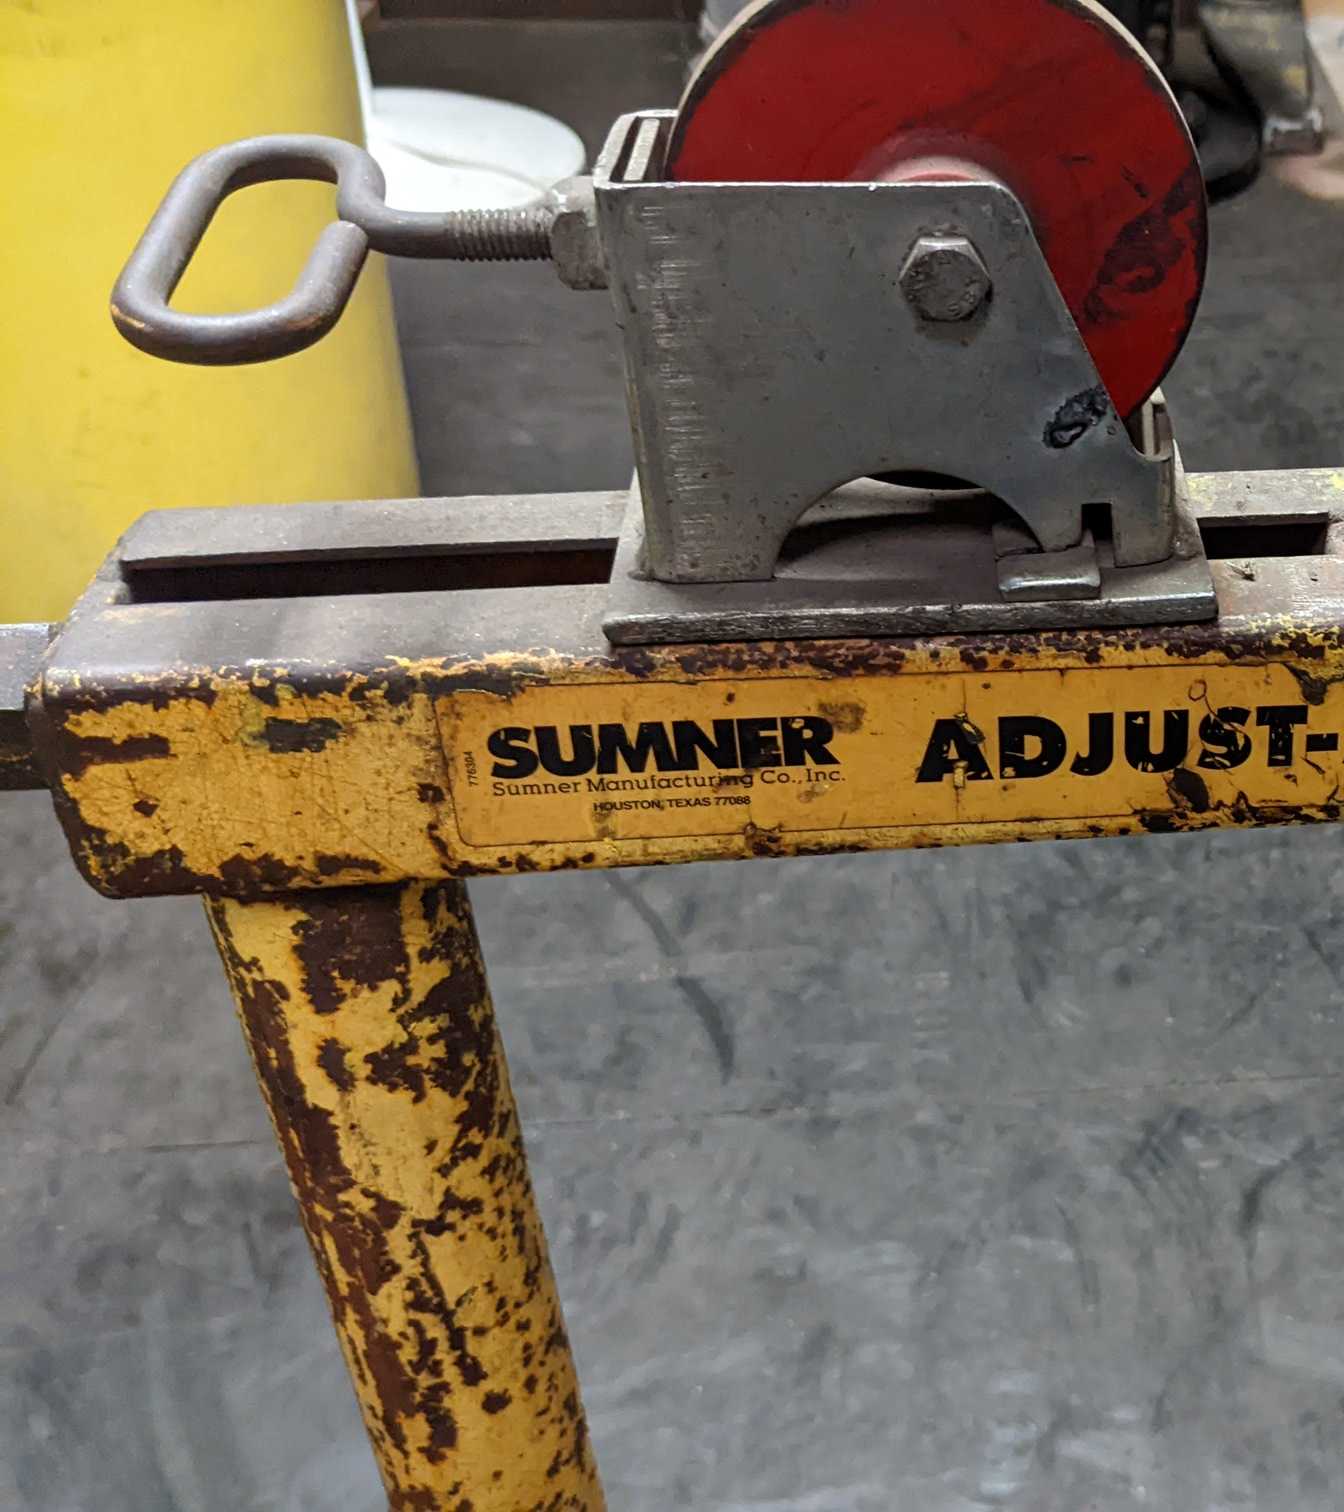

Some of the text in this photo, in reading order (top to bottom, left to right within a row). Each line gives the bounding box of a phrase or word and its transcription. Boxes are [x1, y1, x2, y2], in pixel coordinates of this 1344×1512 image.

[486, 715, 841, 780] SUMNER
[492, 780, 581, 797] Sumner
[588, 773, 754, 793] Manufacturing
[806, 768, 846, 783] Inc.
[593, 800, 665, 812] HOUSTON,
[667, 798, 711, 808] TEXAS
